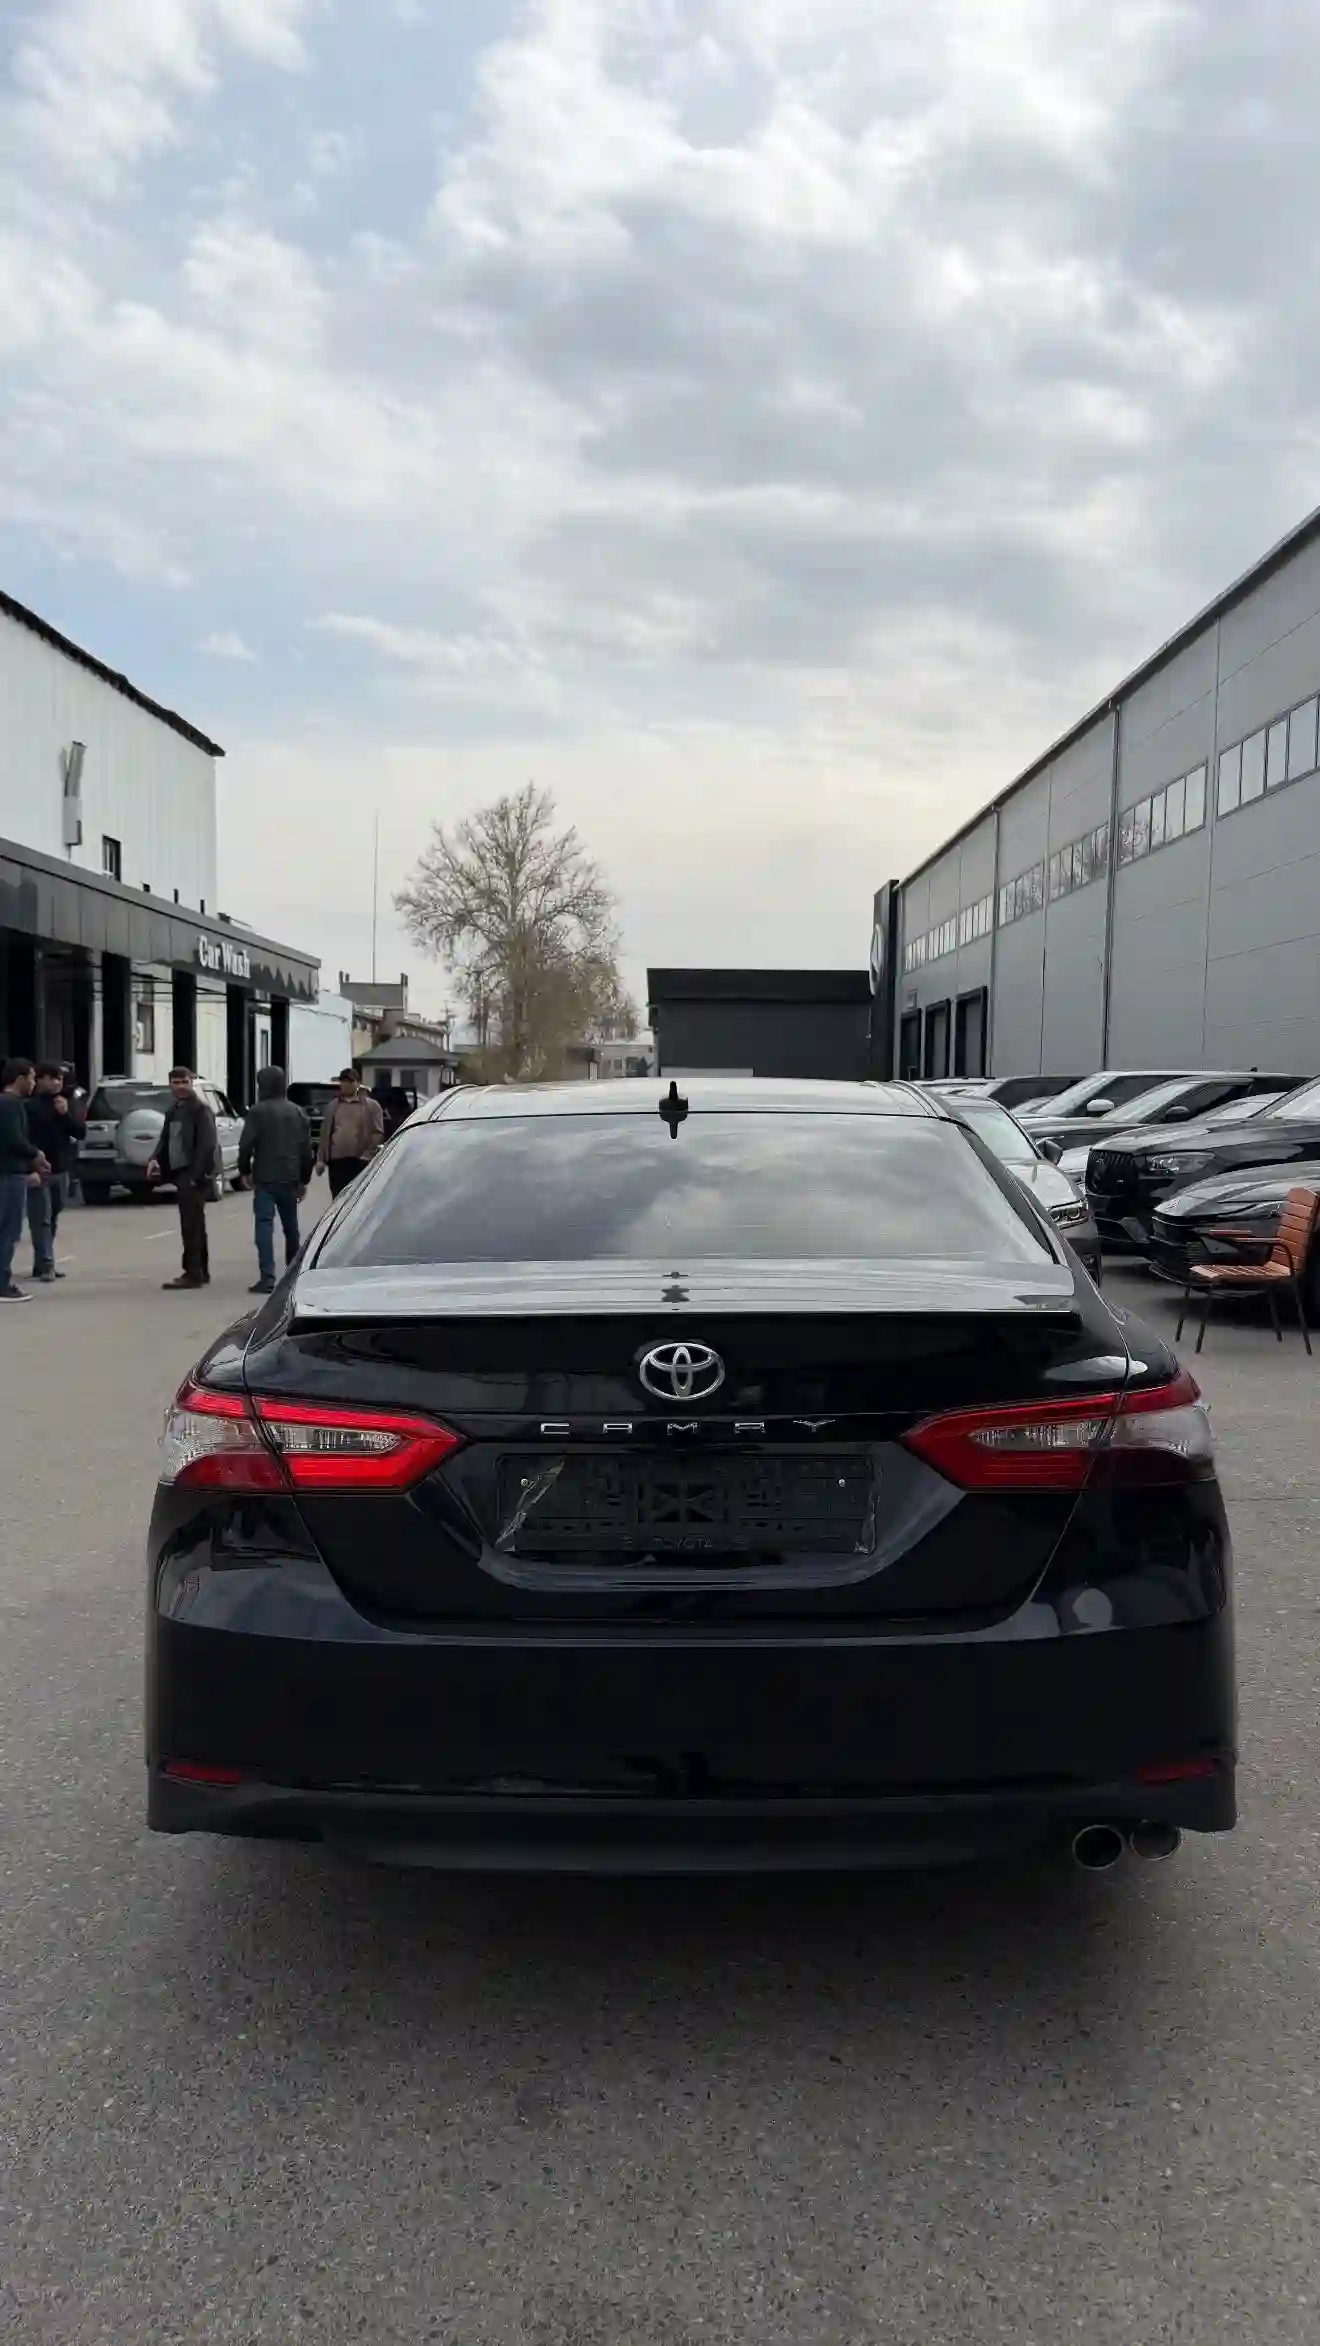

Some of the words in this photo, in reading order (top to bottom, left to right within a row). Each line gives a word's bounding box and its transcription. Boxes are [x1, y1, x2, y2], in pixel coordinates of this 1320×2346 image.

[199, 935, 220, 970] Car
[221, 942, 250, 979] Wash
[540, 1419, 836, 1435] CAMRY
